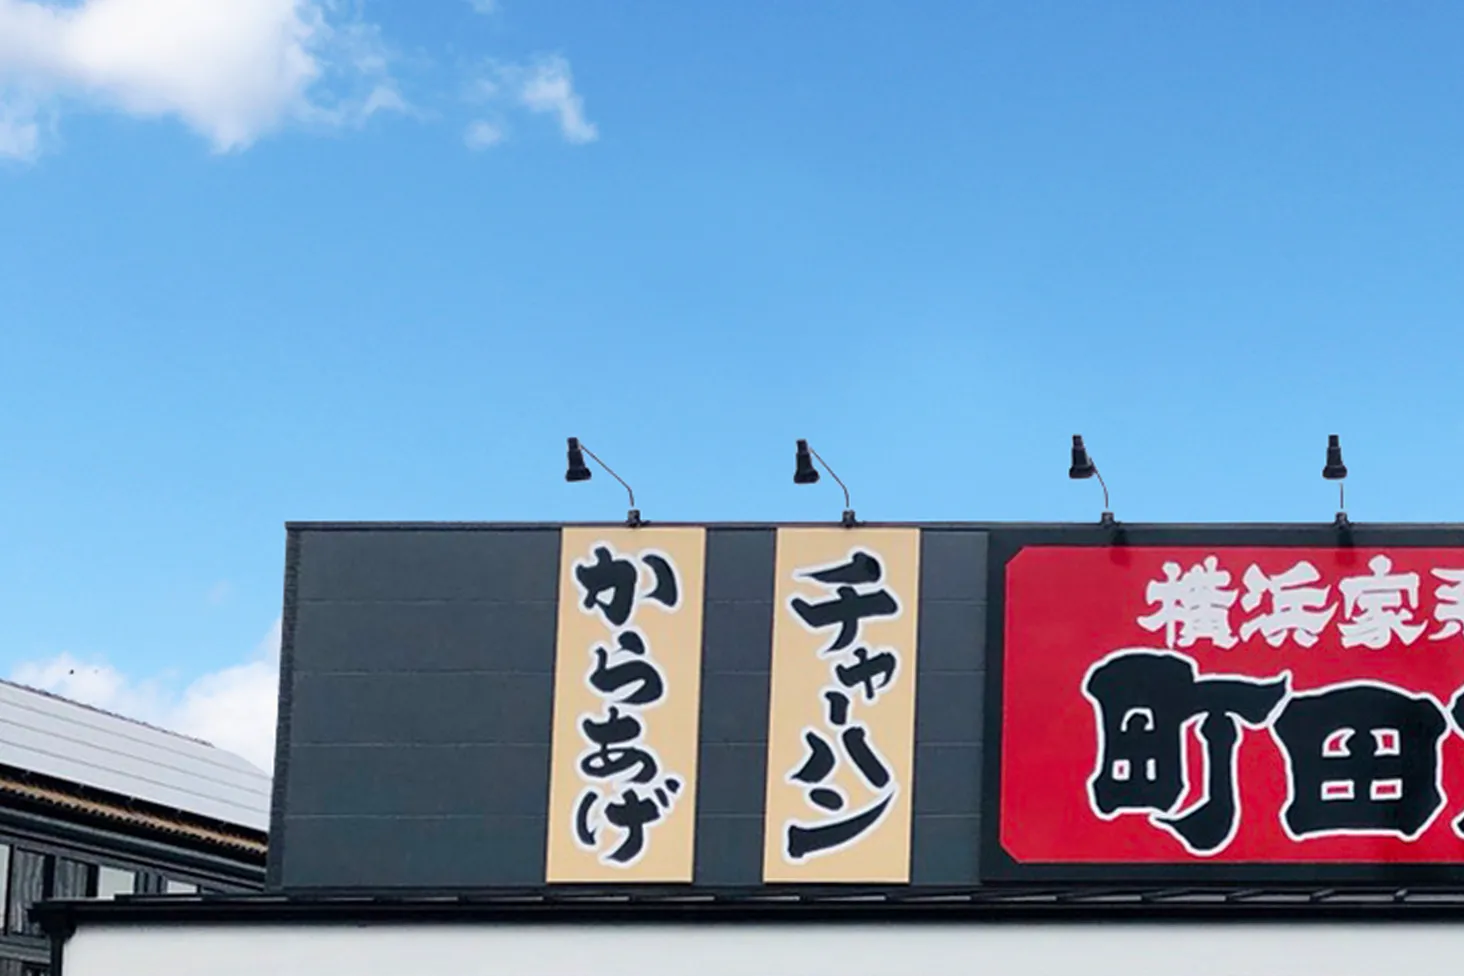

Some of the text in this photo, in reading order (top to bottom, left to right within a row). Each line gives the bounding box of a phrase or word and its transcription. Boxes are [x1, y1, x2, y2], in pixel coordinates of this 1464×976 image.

[574, 545, 682, 864] からあげ
[788, 551, 899, 860] チャーハン
